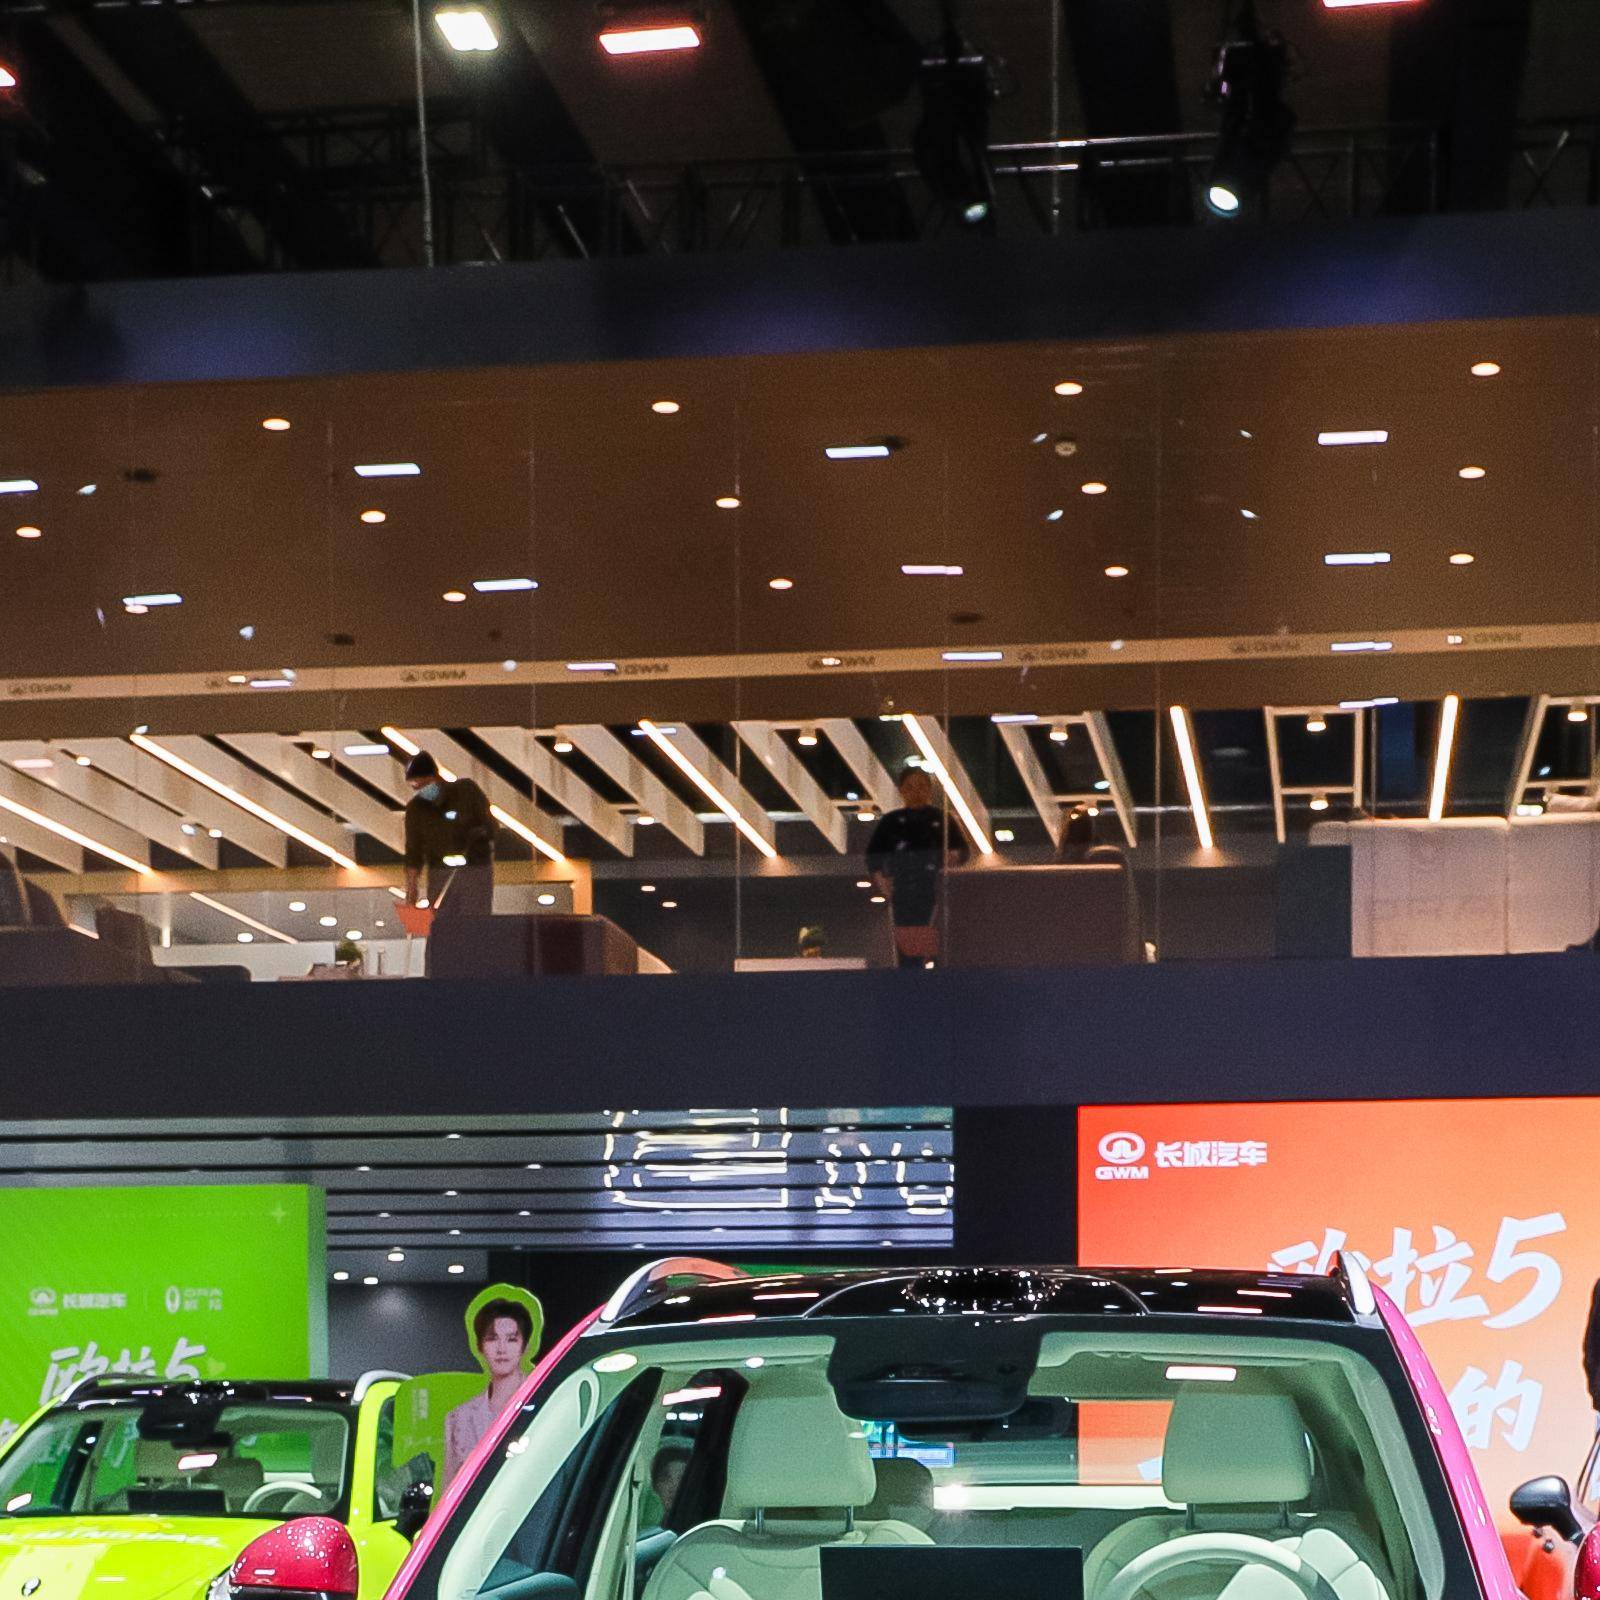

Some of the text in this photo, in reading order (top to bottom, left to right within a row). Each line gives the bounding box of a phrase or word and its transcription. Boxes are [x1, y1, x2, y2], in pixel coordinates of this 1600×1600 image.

[1154, 1140, 1268, 1167] 长城汽车
[1095, 1165, 1149, 1180] GWM
